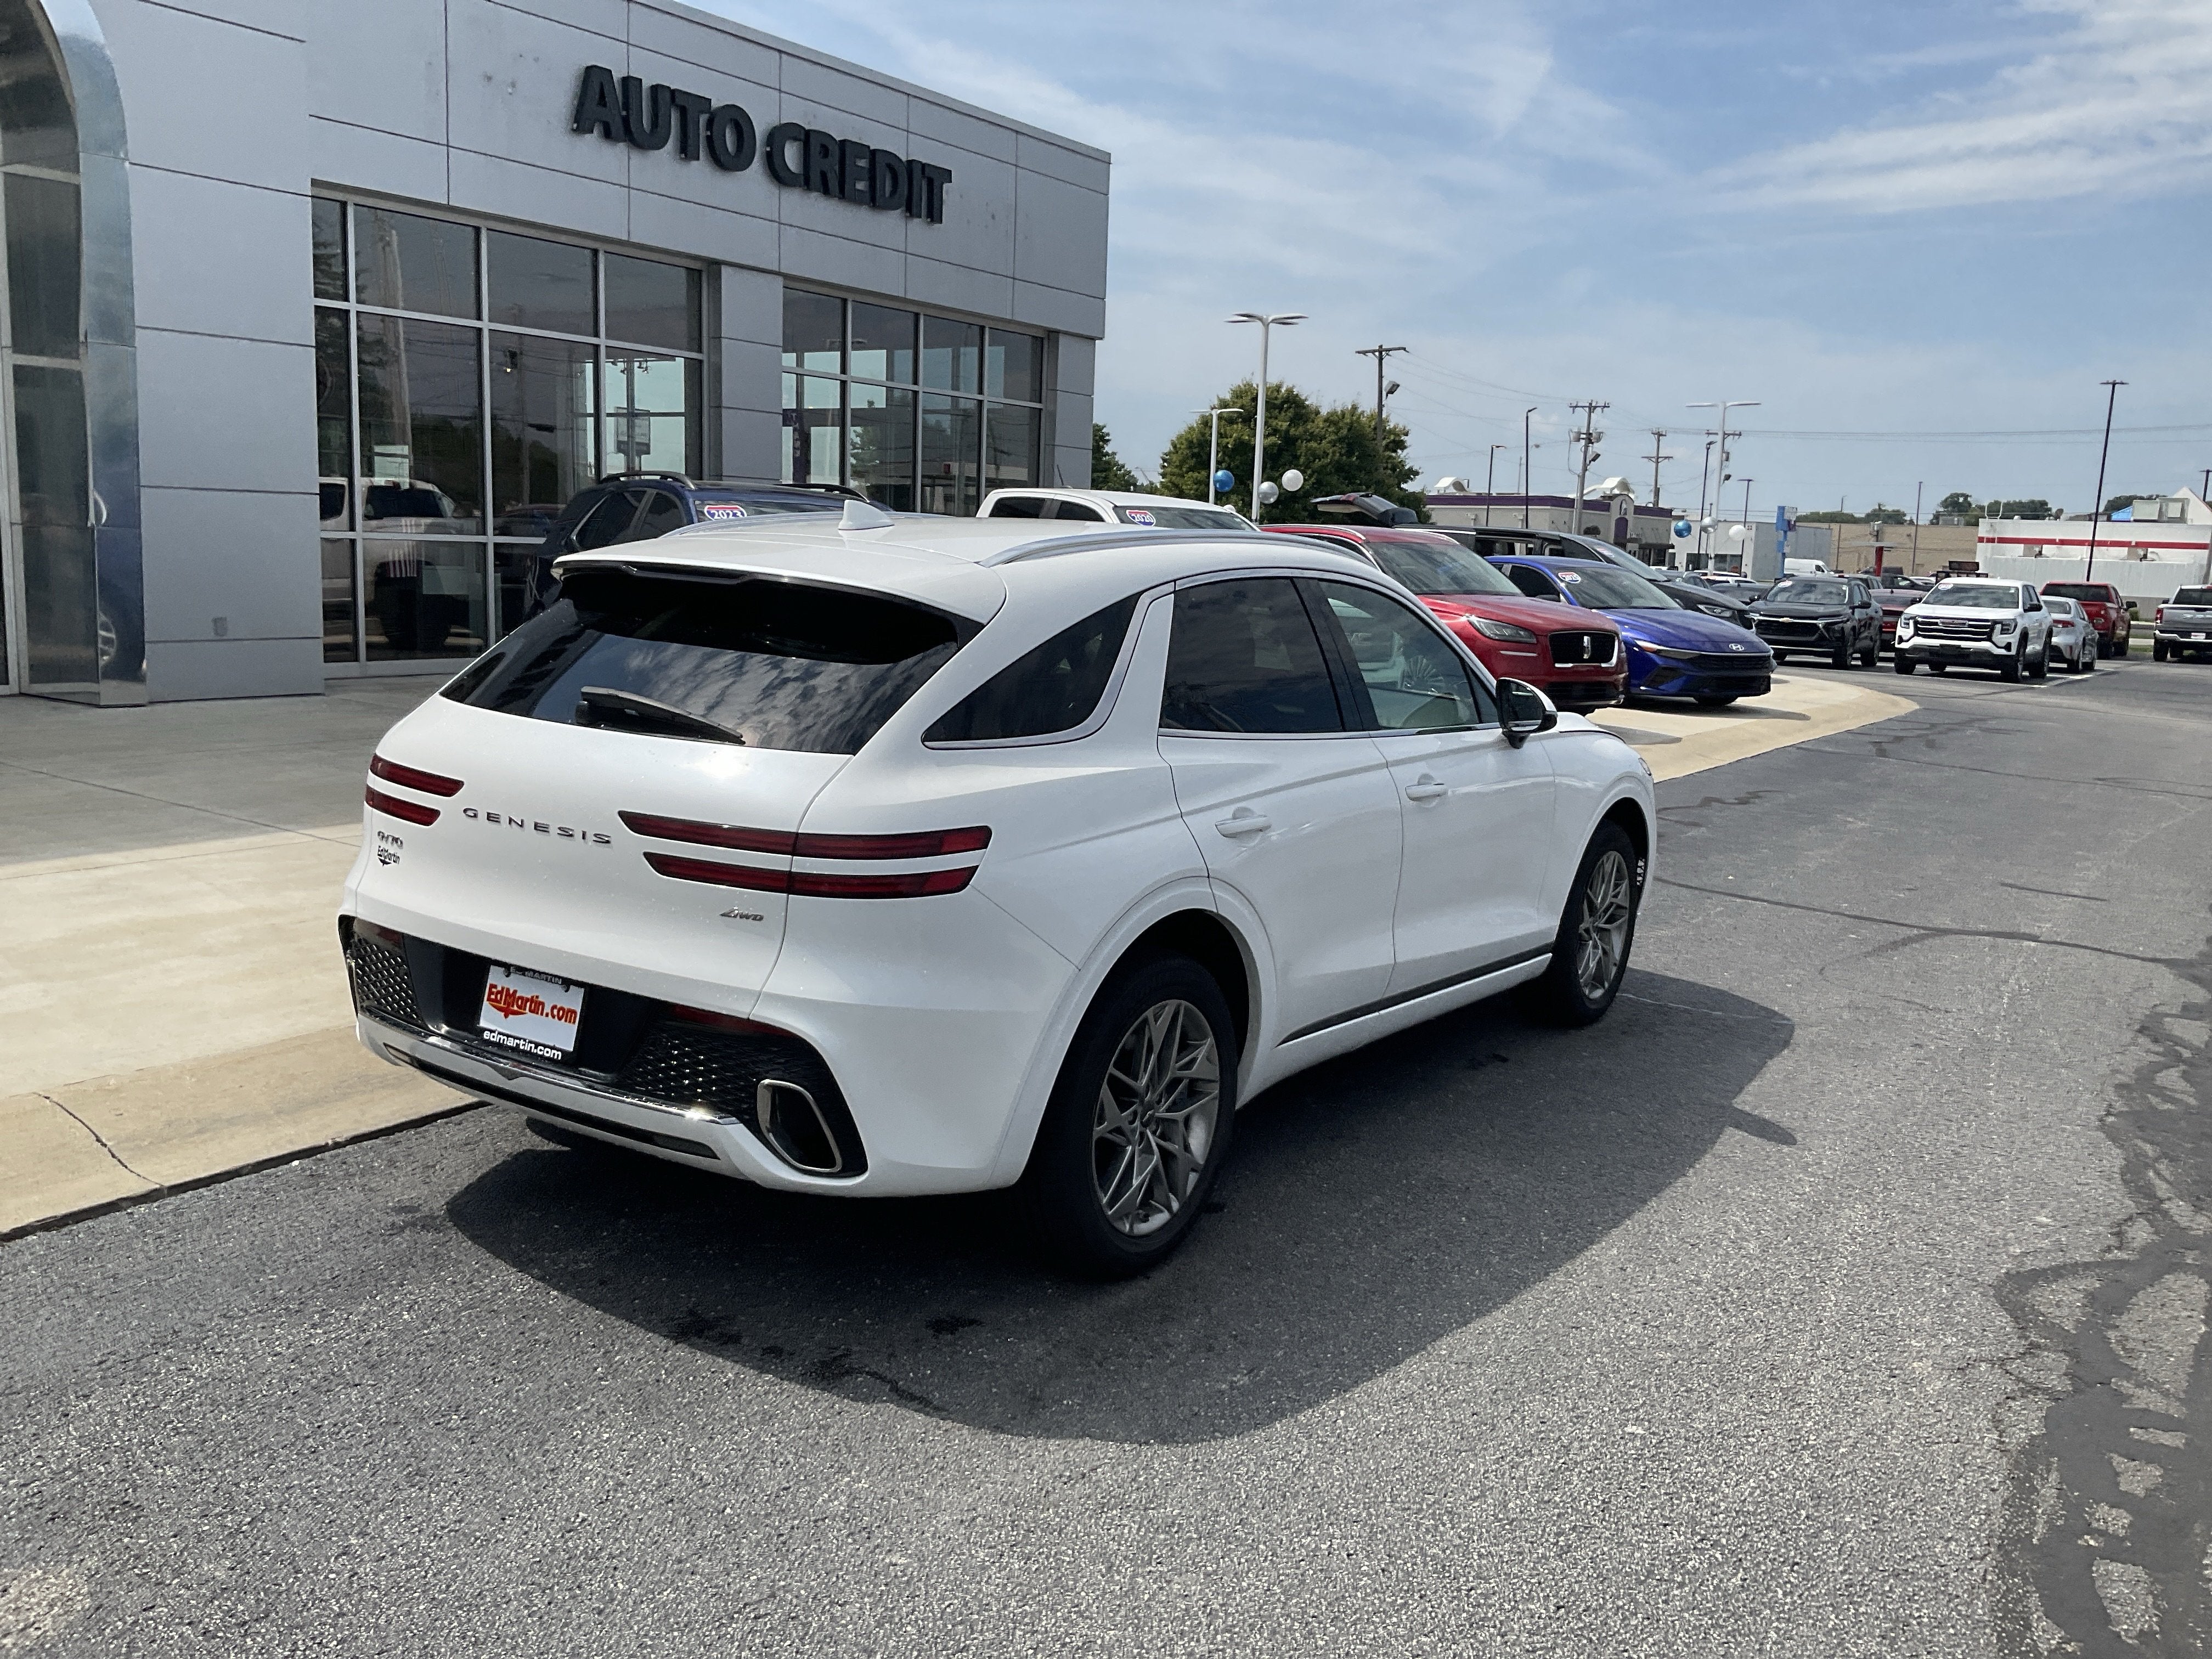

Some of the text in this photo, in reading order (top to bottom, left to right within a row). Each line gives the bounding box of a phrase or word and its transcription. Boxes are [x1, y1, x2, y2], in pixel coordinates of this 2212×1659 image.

[571, 64, 952, 224] AUTO CREDIT
[710, 510, 743, 518] 2023
[462, 808, 611, 844] GENESIS
[486, 983, 578, 1025] EdMartin.com
[483, 1030, 562, 1060] edmartin.com
